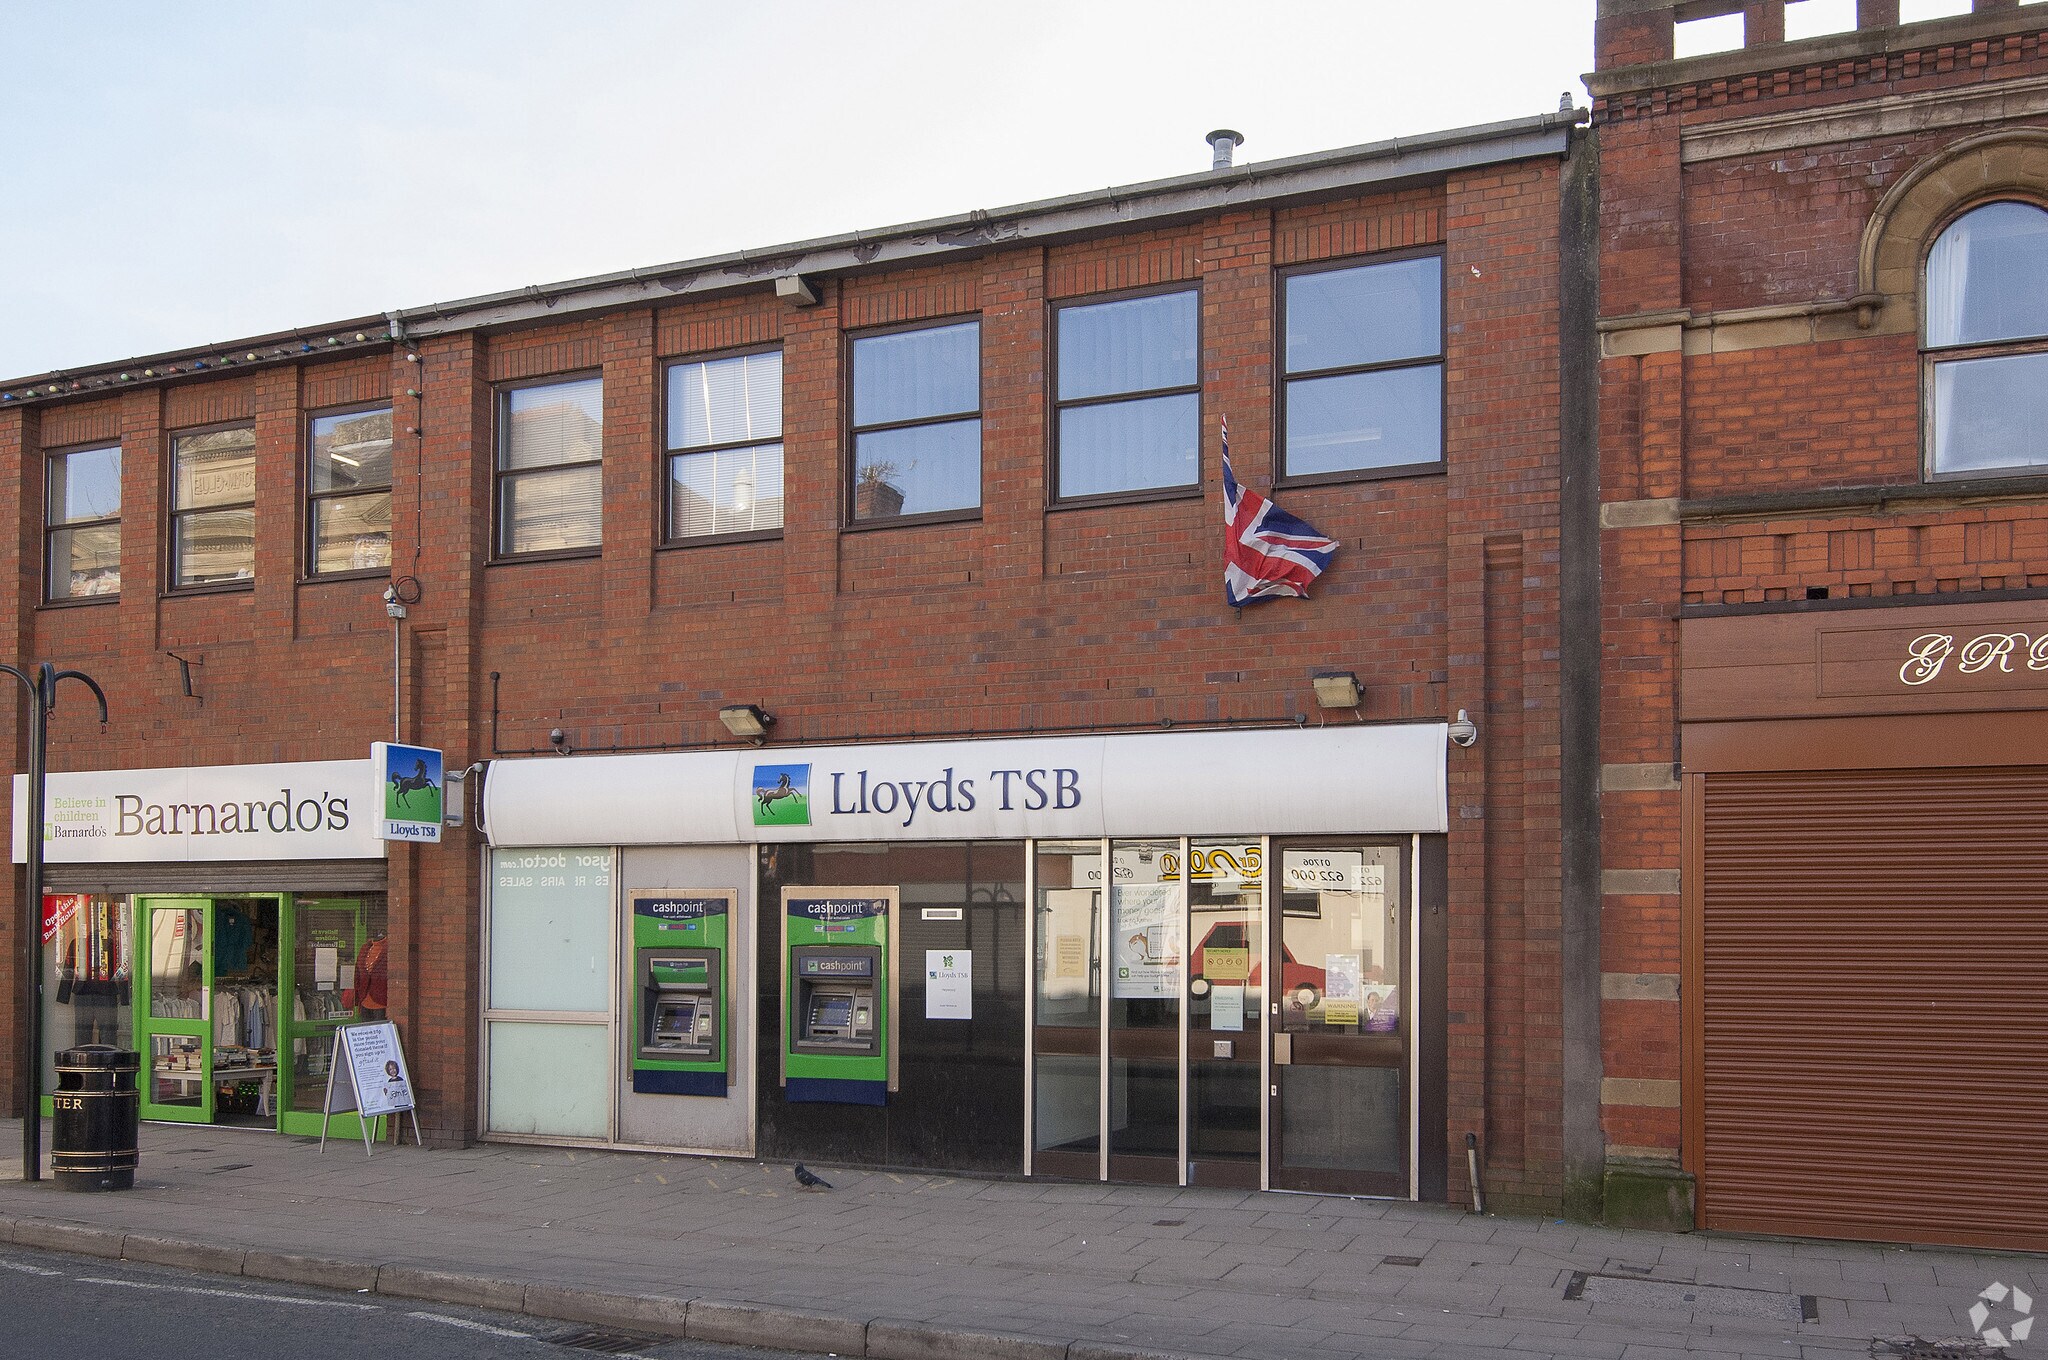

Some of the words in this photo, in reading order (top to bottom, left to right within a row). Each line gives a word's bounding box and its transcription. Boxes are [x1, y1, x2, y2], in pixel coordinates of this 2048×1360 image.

[54, 797, 93, 809] Believe
[95, 796, 106, 808] in
[830, 767, 977, 828] Lloyds
[989, 768, 1082, 812] TSB
[54, 810, 99, 822] children
[115, 788, 350, 837] Barnardo's
[54, 825, 107, 838] Barnardo's
[390, 823, 420, 839] Lloyds
[420, 826, 436, 837] TSB
[1117, 889, 1131, 897] Ever
[1134, 887, 1172, 897] wondered
[45, 910, 62, 927] Open
[61, 898, 74, 912] this
[59, 902, 82, 925] Holiday
[652, 901, 704, 915] cashpoint
[807, 901, 863, 916] cashpoint
[820, 960, 863, 972] cashpoint
[938, 971, 957, 980] Lloyds
[53, 1097, 83, 1110] TER
